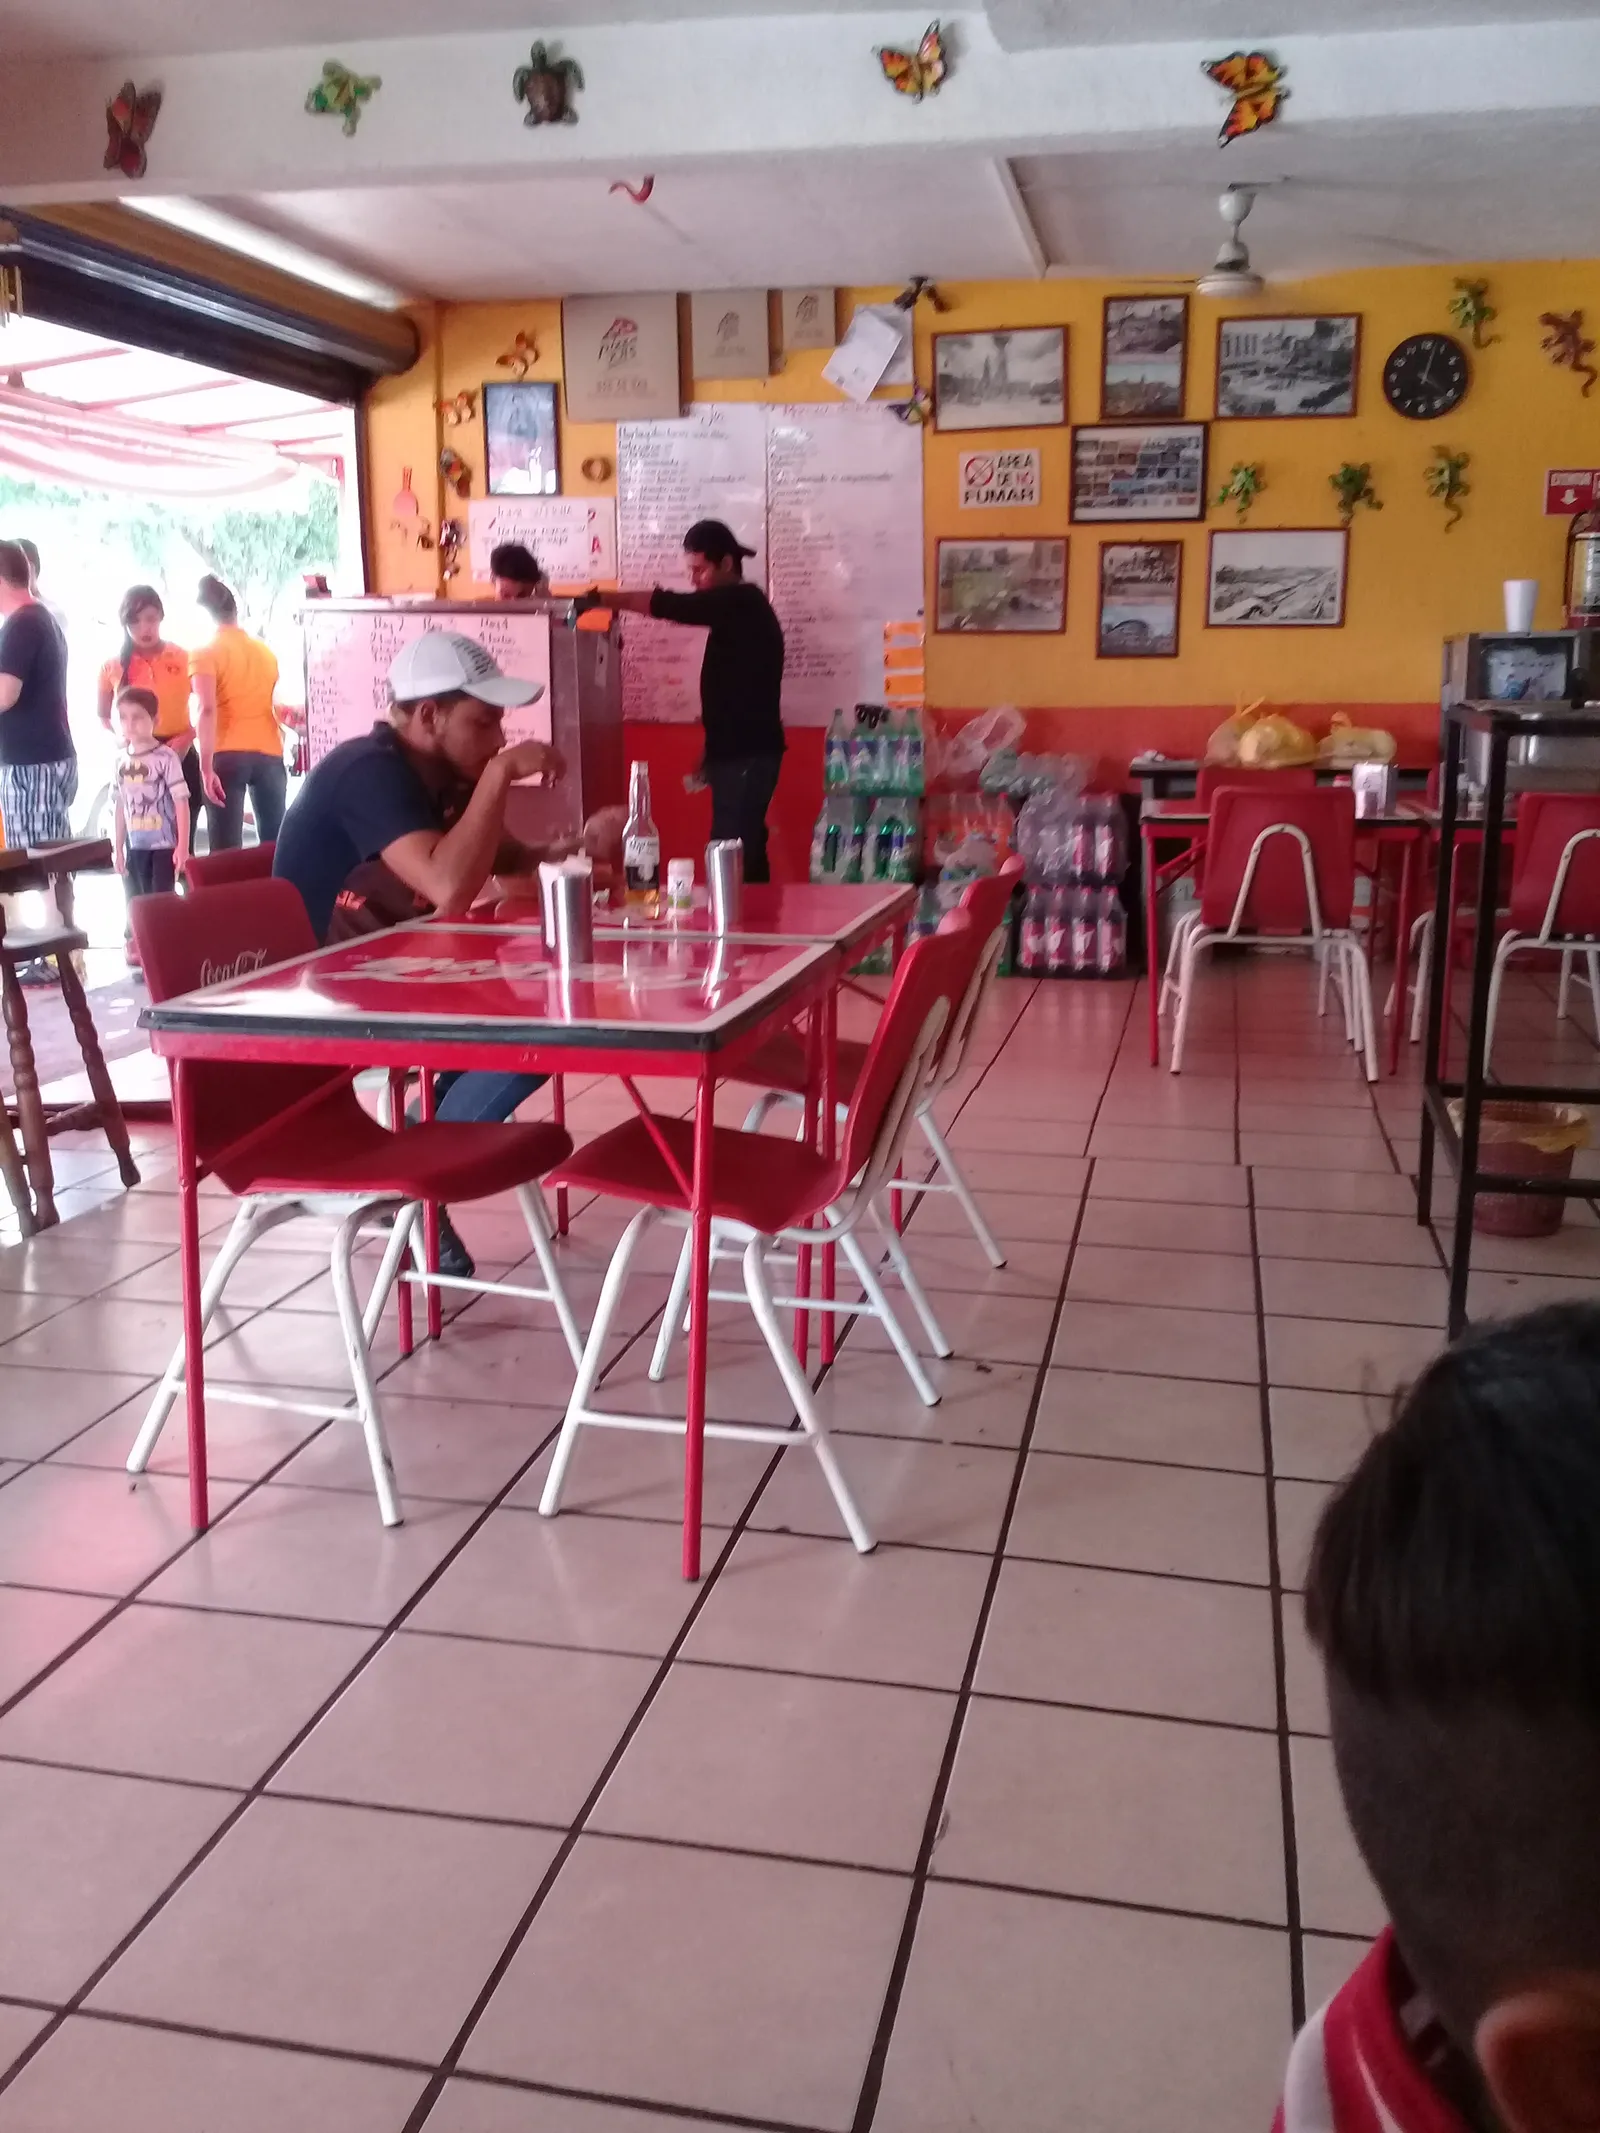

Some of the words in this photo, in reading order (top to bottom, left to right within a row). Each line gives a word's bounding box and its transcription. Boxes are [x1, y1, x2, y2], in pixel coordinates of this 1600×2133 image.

[1421, 340, 1434, 350] 12
[996, 472, 1013, 487] DE
[963, 488, 1035, 504] FUMAR
[200, 948, 267, 988] Coca-Col
